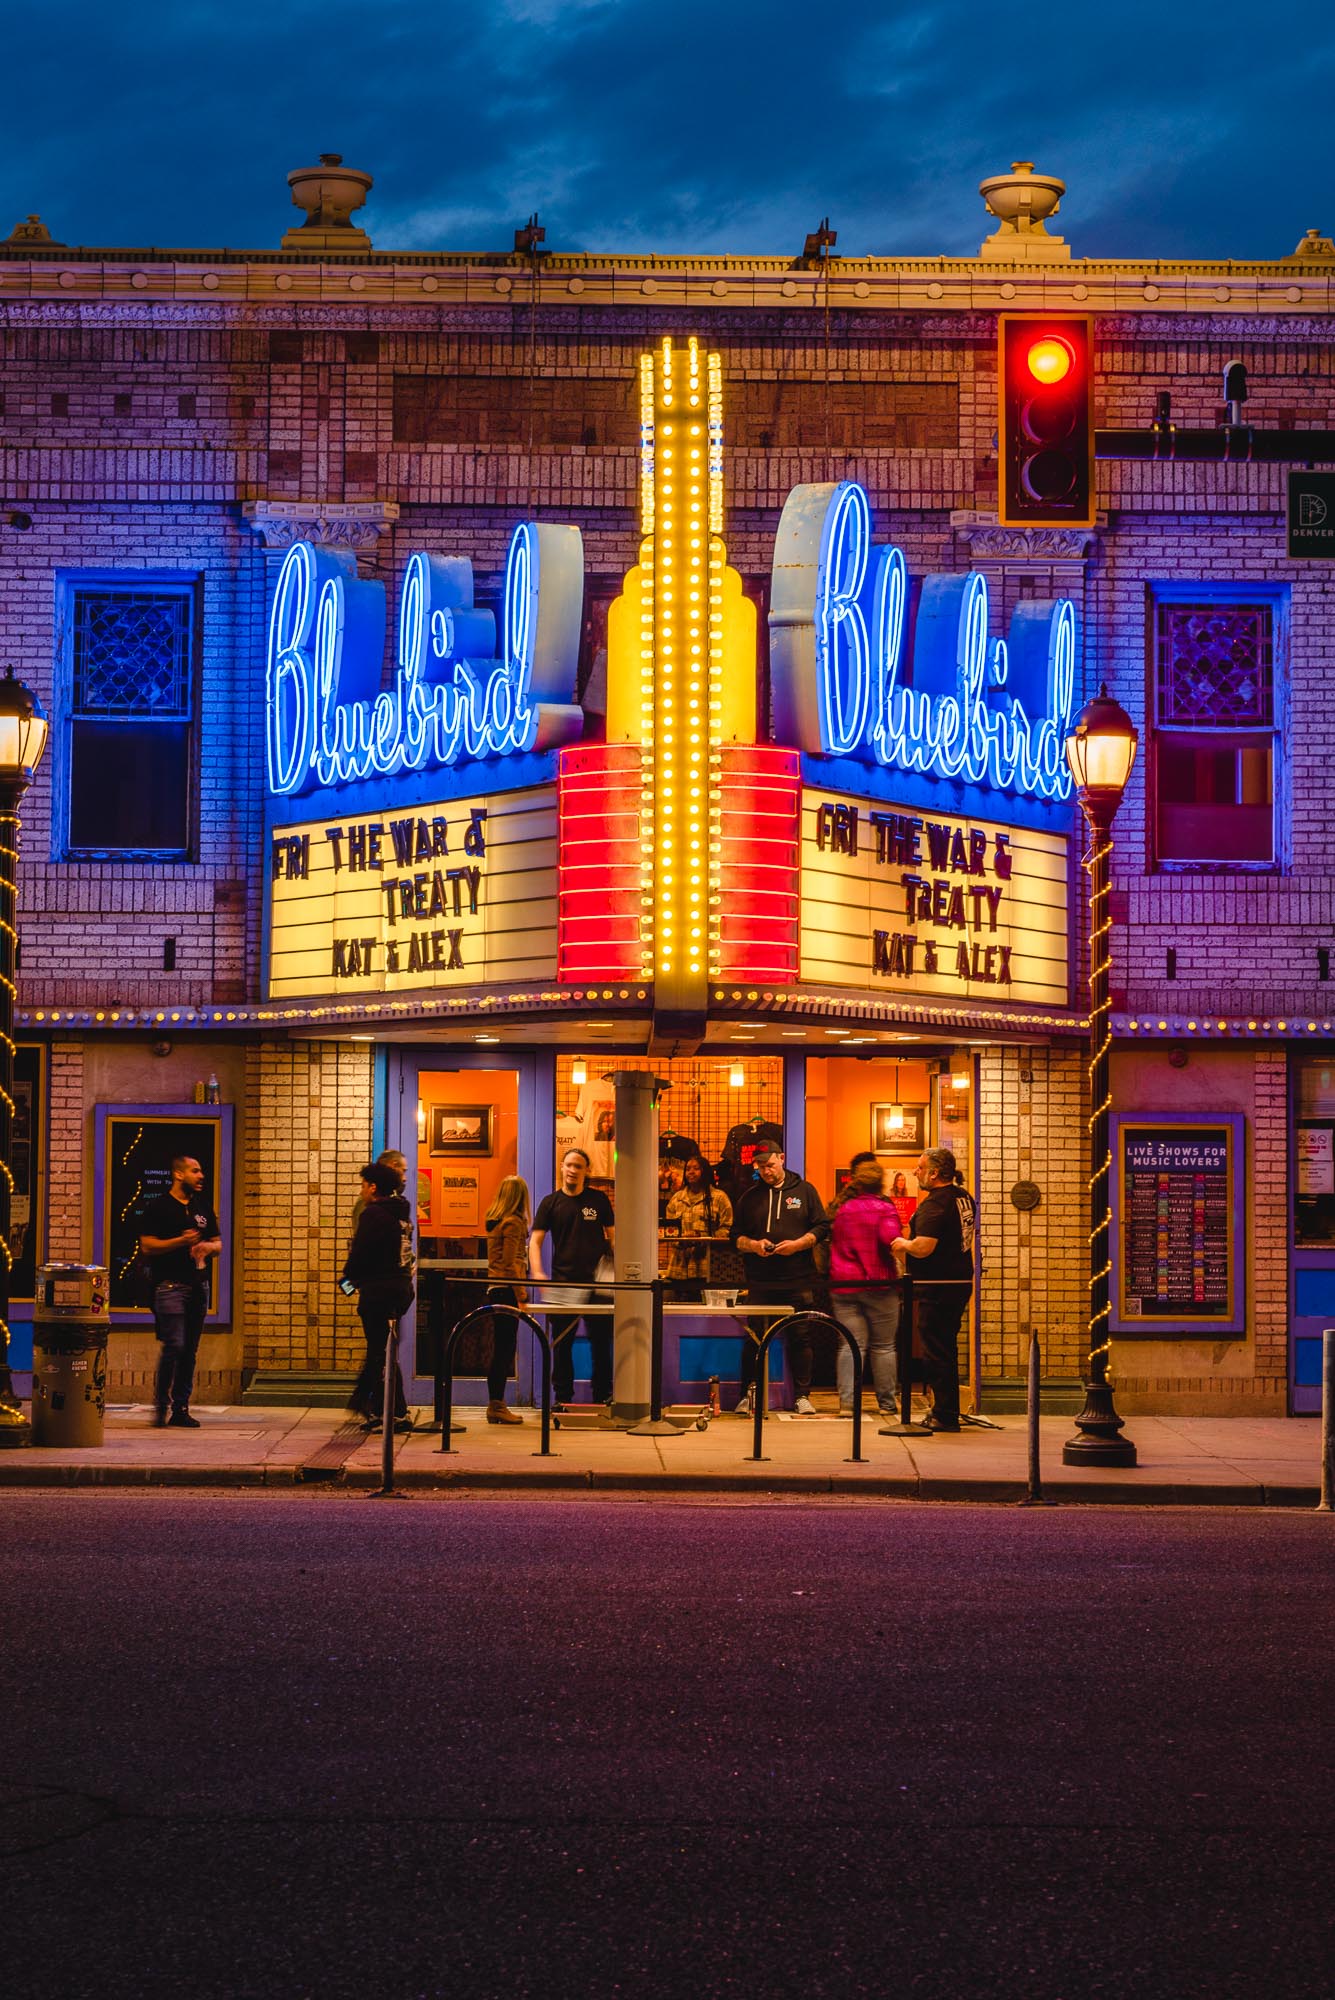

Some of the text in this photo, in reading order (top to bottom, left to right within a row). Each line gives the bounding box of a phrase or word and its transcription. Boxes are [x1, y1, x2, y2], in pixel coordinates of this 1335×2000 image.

[1292, 528, 1334, 537] DENVER
[265, 522, 534, 794] Bluebird
[819, 482, 1077, 800] Bluebird
[272, 833, 310, 881] FRI
[325, 823, 385, 875] THE
[389, 816, 449, 868] WAR
[816, 802, 1012, 881] FRI THE WAR &
[381, 866, 481, 926] TREATY
[901, 873, 1003, 932] TREATY
[332, 928, 465, 978] KAT & ALEX
[872, 929, 1013, 984] KAT & ALEX
[1127, 1147, 1227, 1156] LIVE SHOWS FOR
[1133, 1157, 1220, 1166] MUSIC LOVERS
